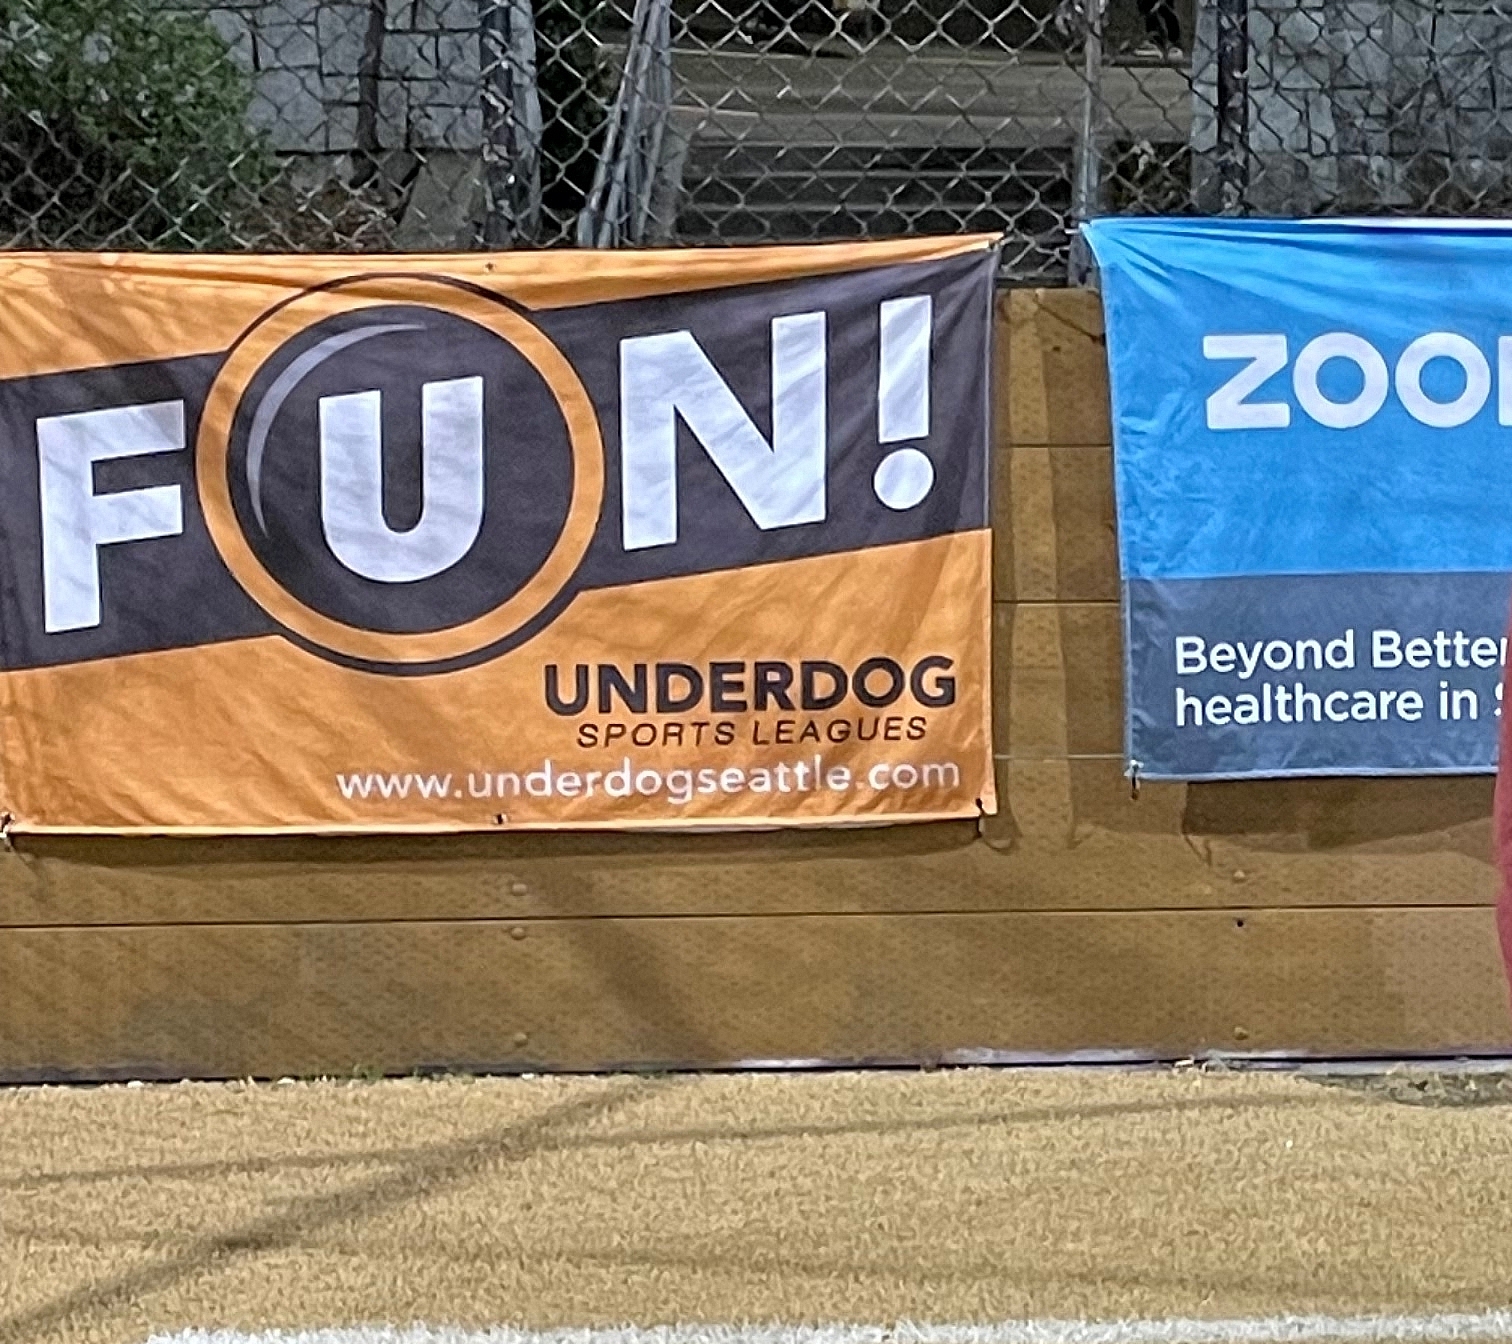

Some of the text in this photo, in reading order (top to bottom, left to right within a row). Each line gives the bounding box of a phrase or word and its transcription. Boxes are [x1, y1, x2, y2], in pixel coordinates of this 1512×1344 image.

[36, 295, 936, 634] FUN!
[1175, 628, 1355, 680] Beyond
[544, 655, 957, 717] UNDERDOG
[1175, 682, 1424, 727] healthcare
[1439, 680, 1479, 720] in
[576, 715, 928, 749] SPORTS LEAGUES
[335, 754, 961, 805] www.underdogseattle.com
